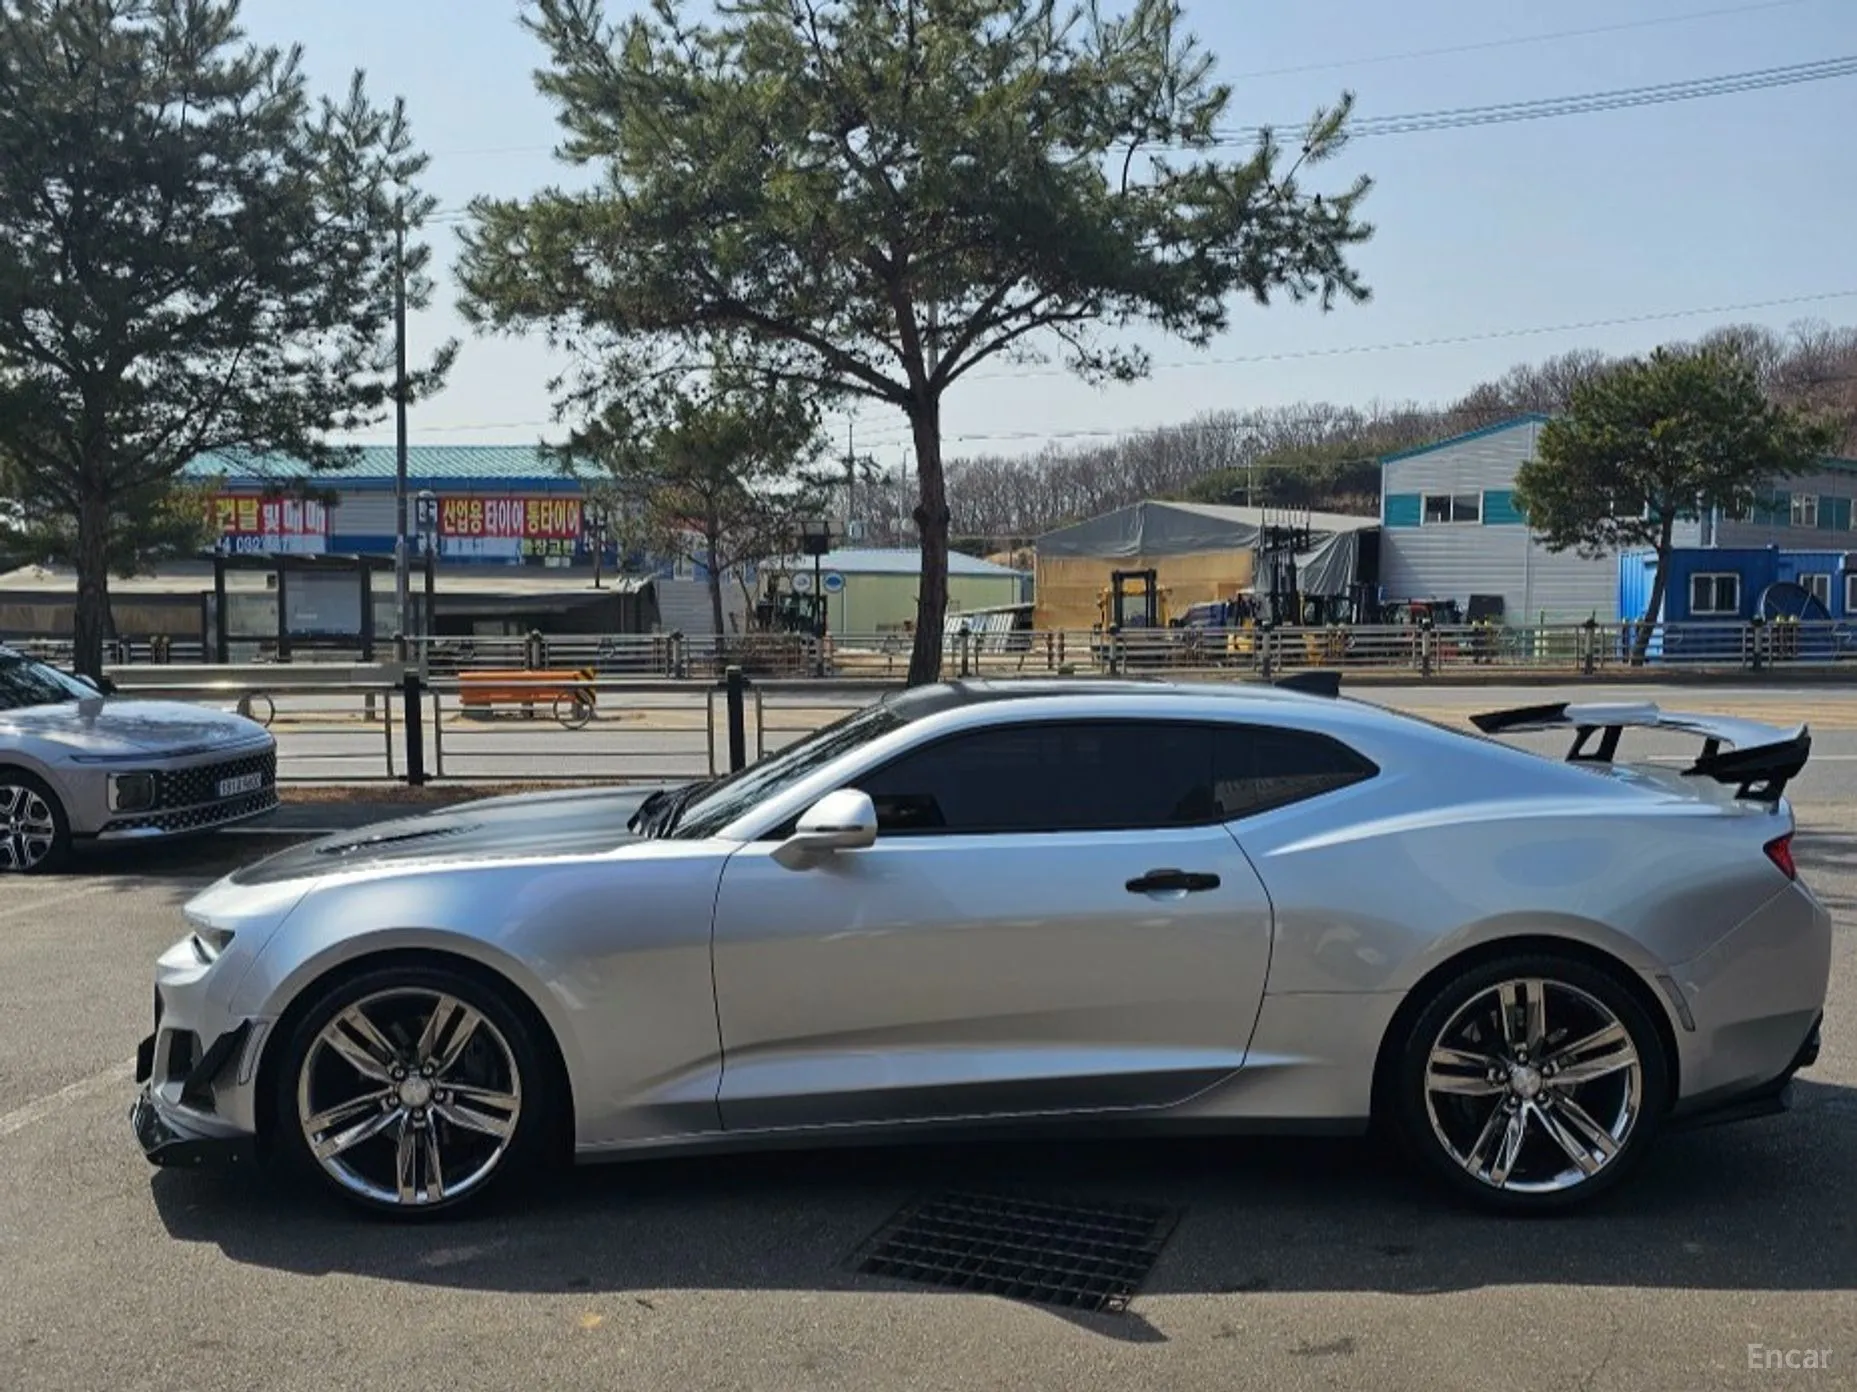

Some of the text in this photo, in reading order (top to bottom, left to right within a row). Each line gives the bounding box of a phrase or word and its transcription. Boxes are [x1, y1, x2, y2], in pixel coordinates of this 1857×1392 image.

[262, 503, 281, 534] 및
[282, 499, 327, 533] 매매
[442, 500, 484, 534] 산업용
[485, 499, 525, 536] 타이어
[527, 499, 581, 536] 통타이어
